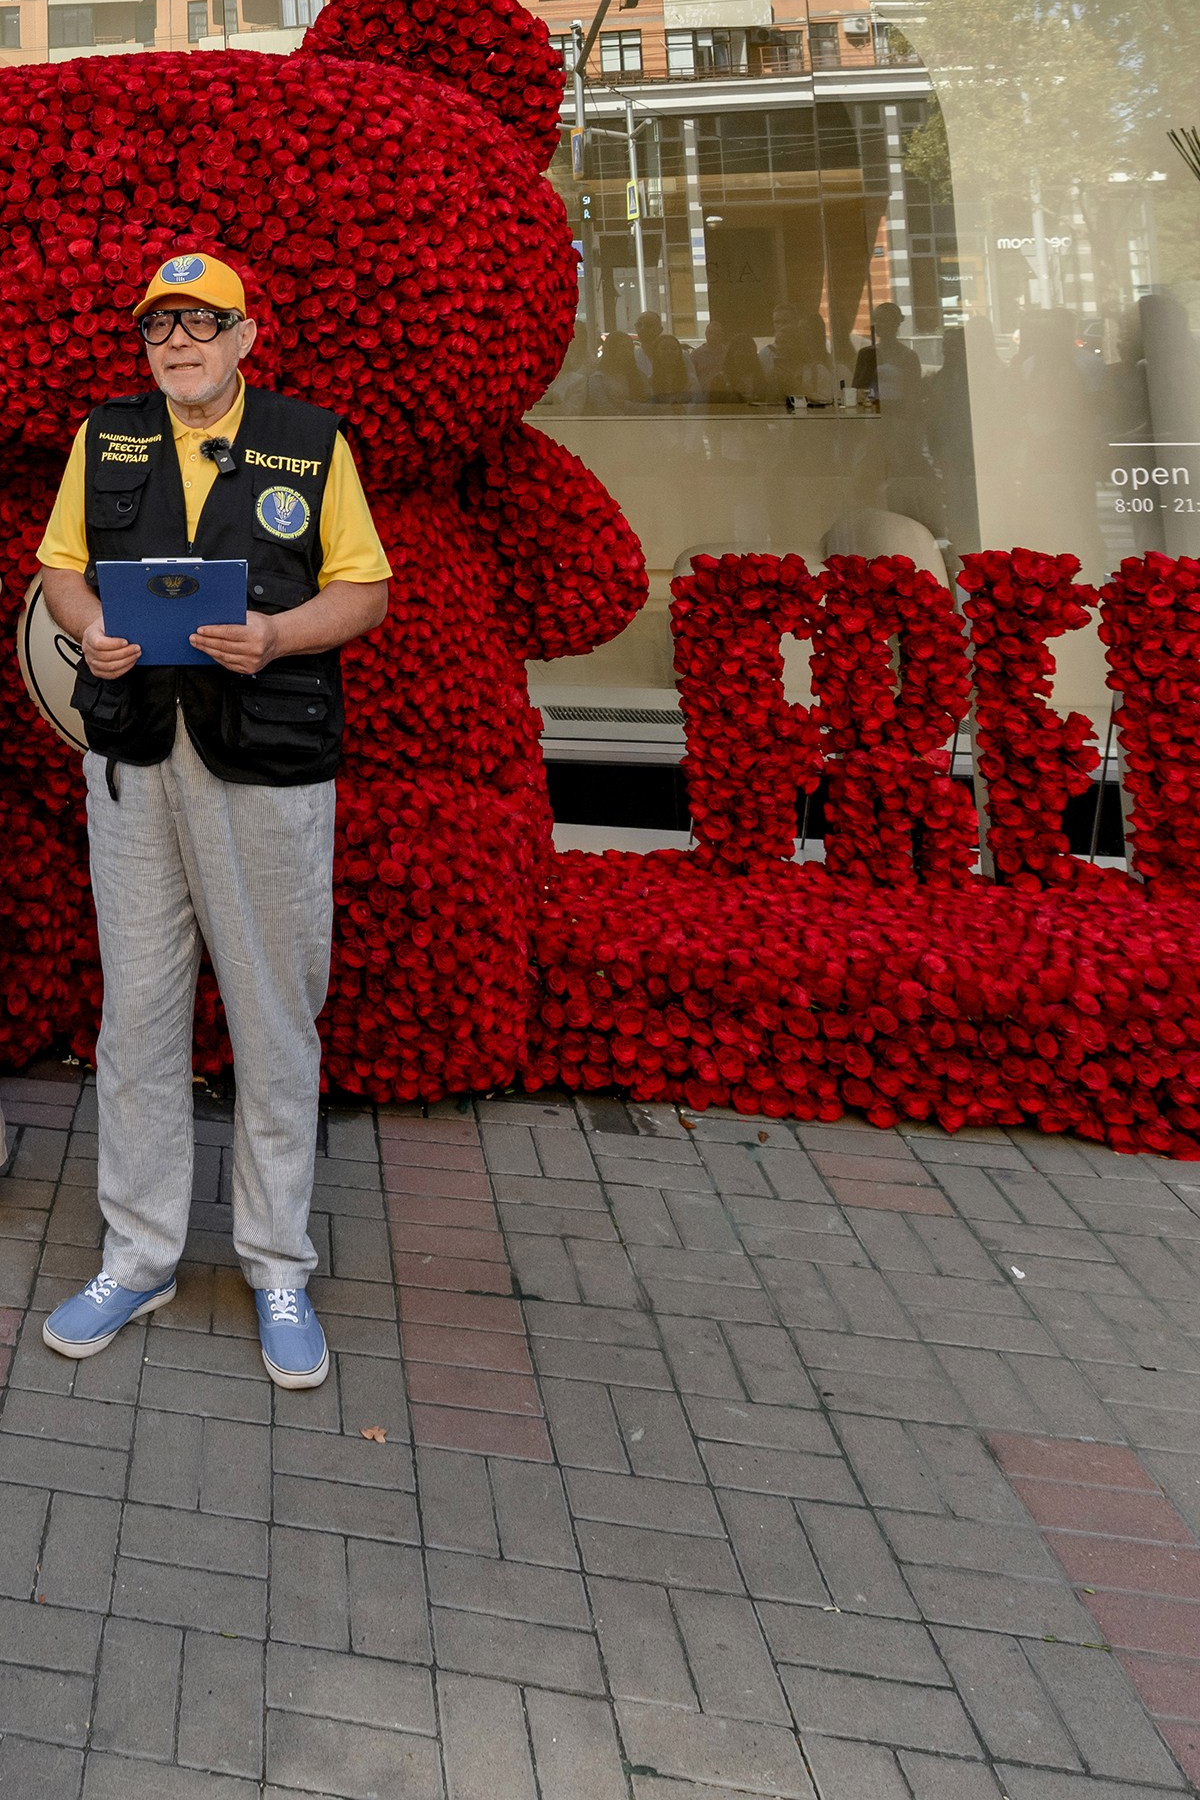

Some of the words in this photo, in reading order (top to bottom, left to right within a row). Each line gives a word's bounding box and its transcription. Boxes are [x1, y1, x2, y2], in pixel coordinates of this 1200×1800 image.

[99, 432, 162, 443] НАЦІОНАЛЬНИЙ
[108, 442, 147, 454] РЕЄСТР
[101, 452, 149, 463] РЕКОРДІВ
[244, 449, 322, 477] ЕКСПЕРТ
[1111, 467, 1190, 490] open
[1115, 498, 1154, 513] 8:00
